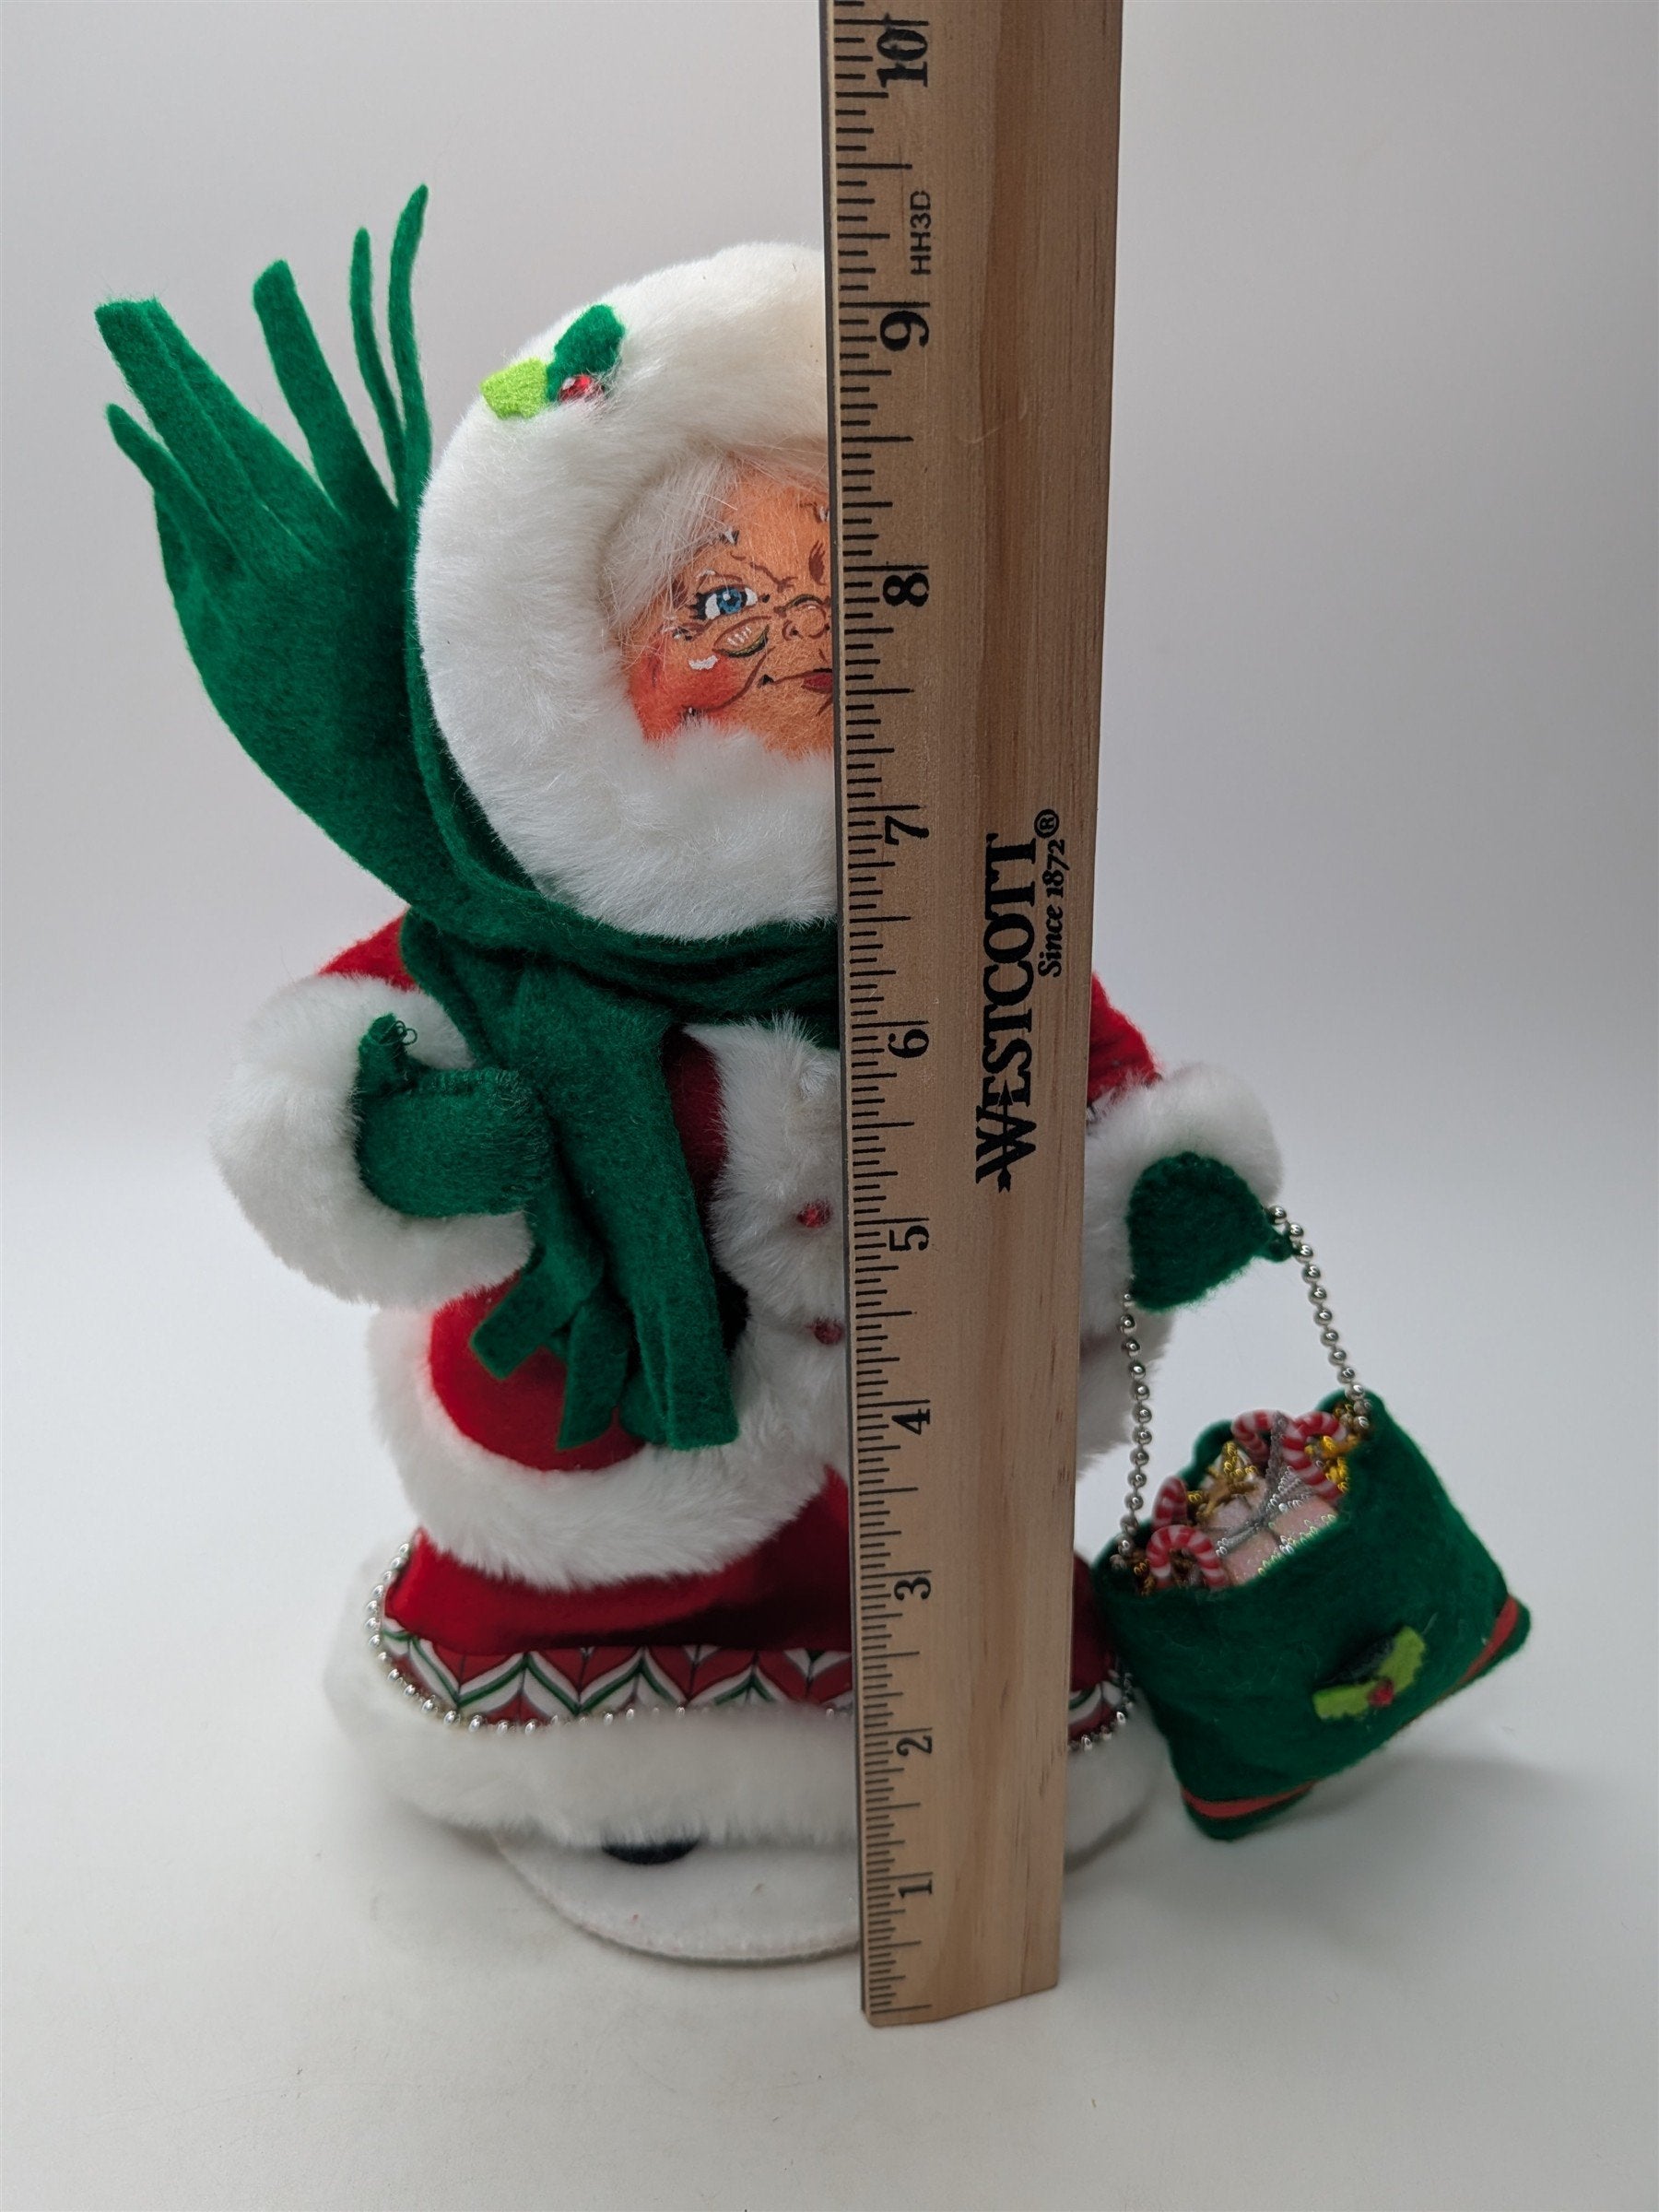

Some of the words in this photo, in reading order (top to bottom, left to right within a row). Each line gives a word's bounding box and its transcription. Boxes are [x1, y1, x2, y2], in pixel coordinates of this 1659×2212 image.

[877, 29, 928, 88] 10
[910, 190, 931, 275] HH3D
[880, 311, 930, 351] 9
[882, 572, 930, 606] 8
[885, 816, 930, 845] 7
[1043, 839, 1070, 901] 1872
[1038, 907, 1064, 978] Since
[888, 1029, 930, 1059] 6
[889, 1225, 930, 1252] 5
[891, 1408, 931, 1435] 4
[893, 1576, 932, 1601] 3
[896, 1735, 933, 1757] 2
[898, 1878, 933, 1896] 1
